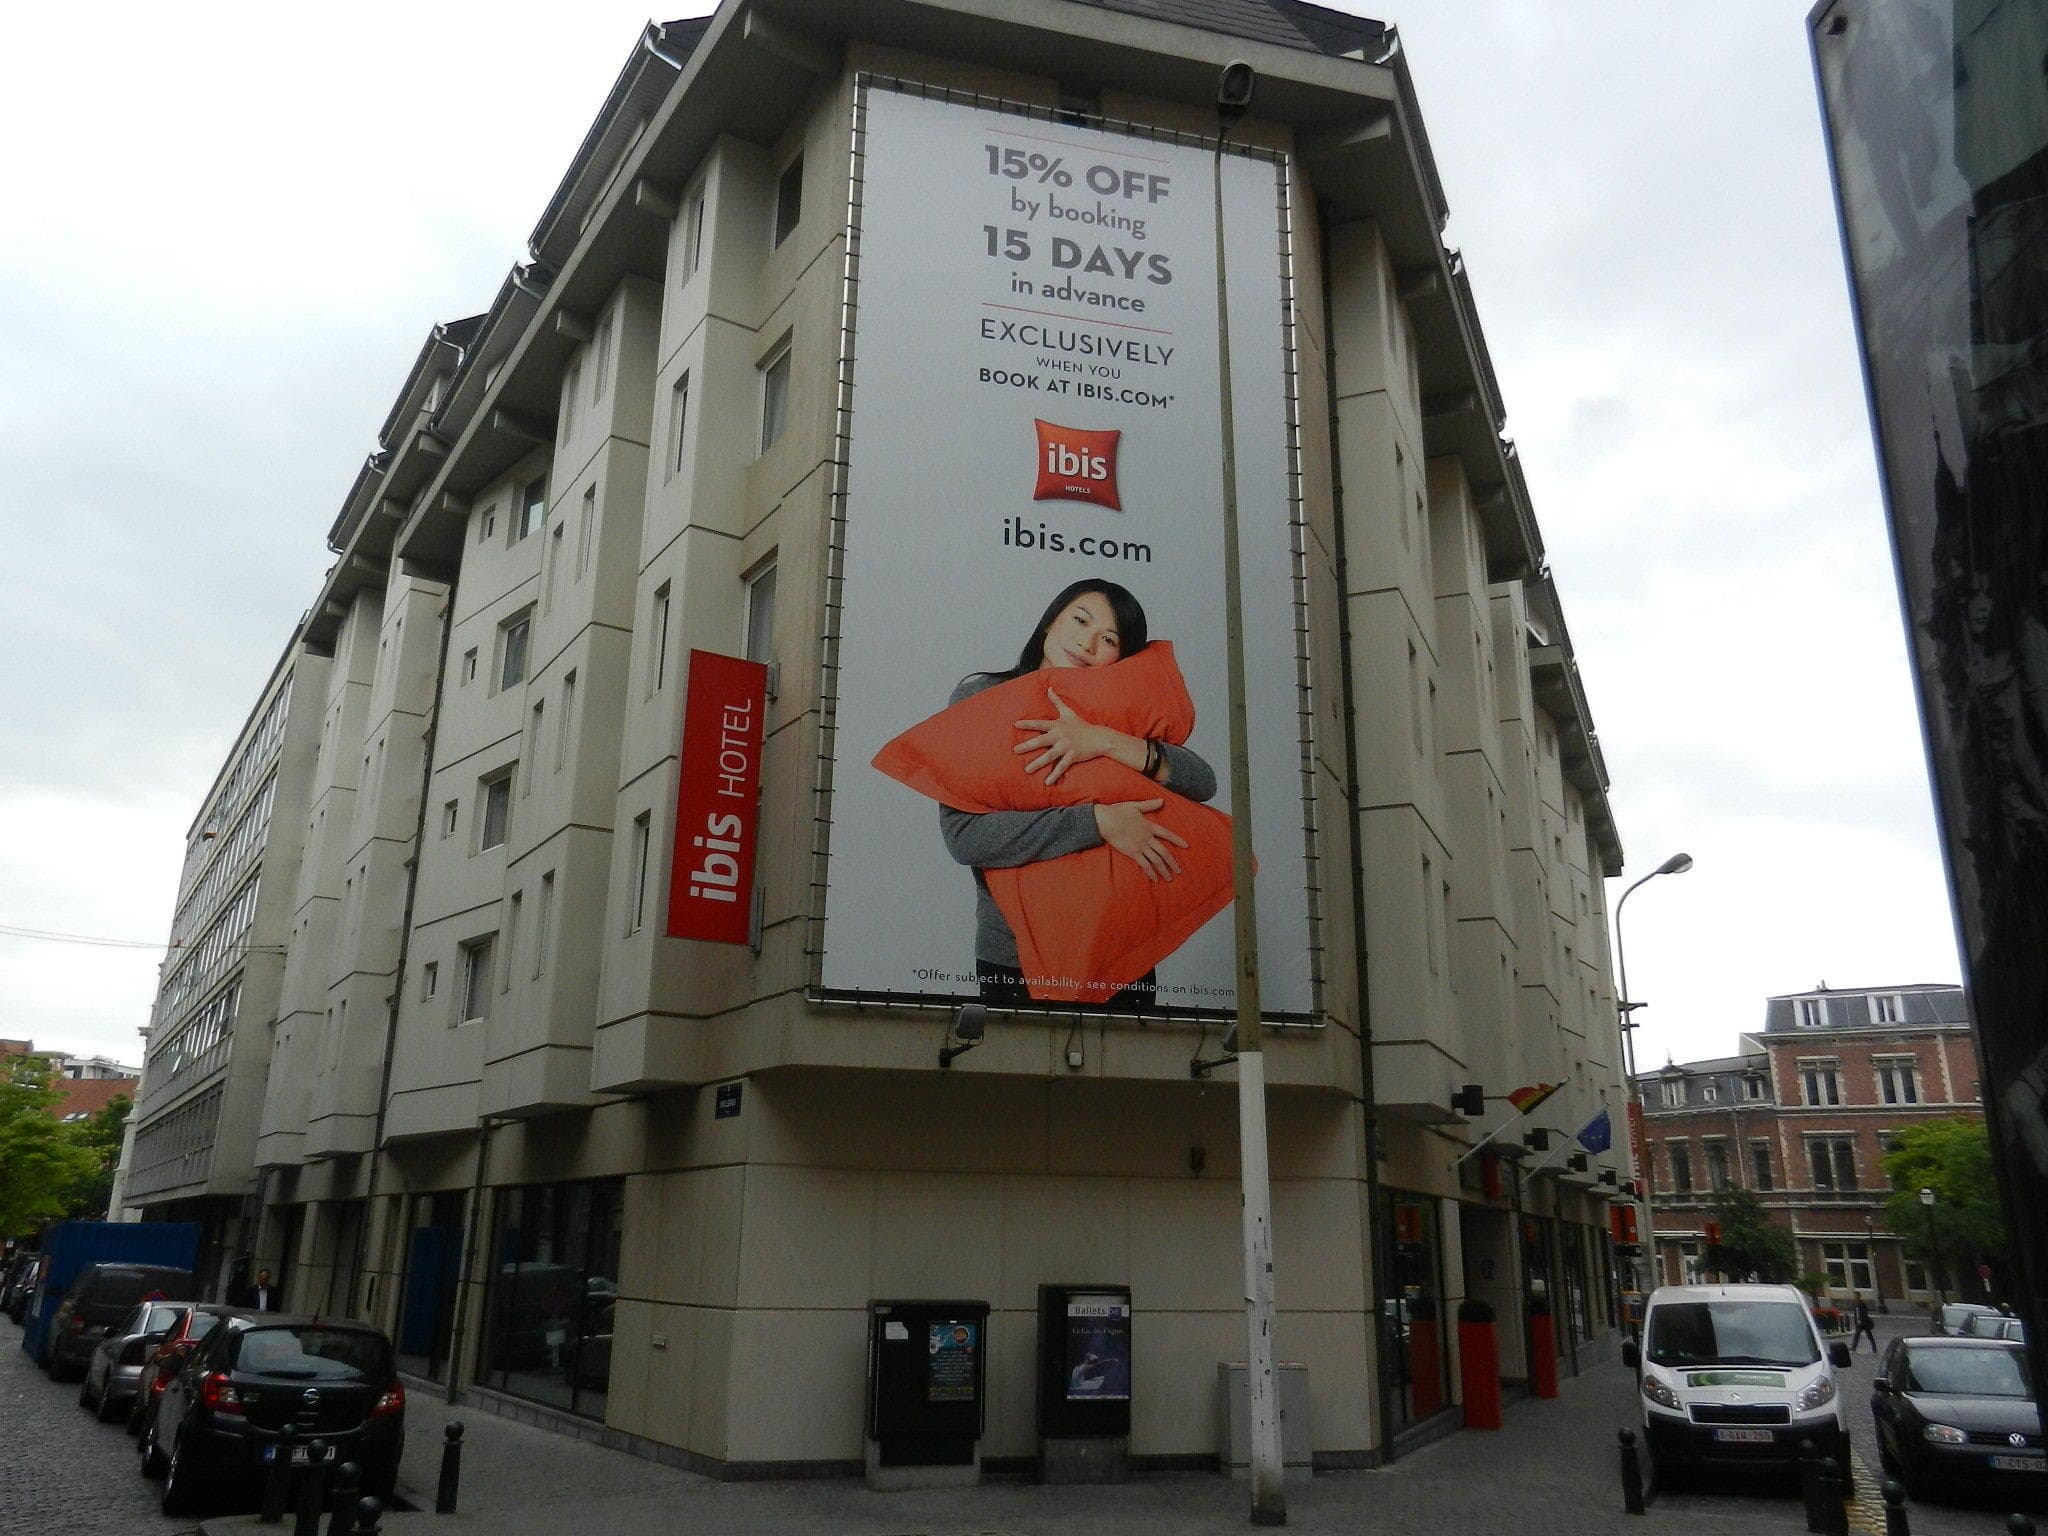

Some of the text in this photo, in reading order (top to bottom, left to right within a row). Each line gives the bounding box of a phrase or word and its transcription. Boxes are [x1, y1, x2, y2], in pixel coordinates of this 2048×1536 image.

[985, 144, 1170, 204] 15% OFF
[1011, 187, 1146, 240] by booking
[983, 225, 1172, 285] 15 DAYS
[1011, 272, 1146, 313] in advance
[981, 318, 1174, 366] EXCLUSIVELY
[979, 367, 1040, 390] BOOK
[1046, 379, 1070, 394] AT
[1036, 356, 1121, 380] WHEN YOU
[1048, 442, 1107, 480] ibis
[1065, 484, 1091, 494] HOTELS
[1003, 517, 1152, 563] ibis.com
[689, 698, 752, 903] ibis HOTEL
[955, 971, 999, 985] subject
[1003, 973, 1015, 984] to
[1087, 980, 1106, 989] see
[1110, 980, 1169, 993] conditions
[1172, 985, 1187, 994] on
[1190, 984, 1235, 997] ibis.com
[1075, 1306, 1106, 1315] Ballets
